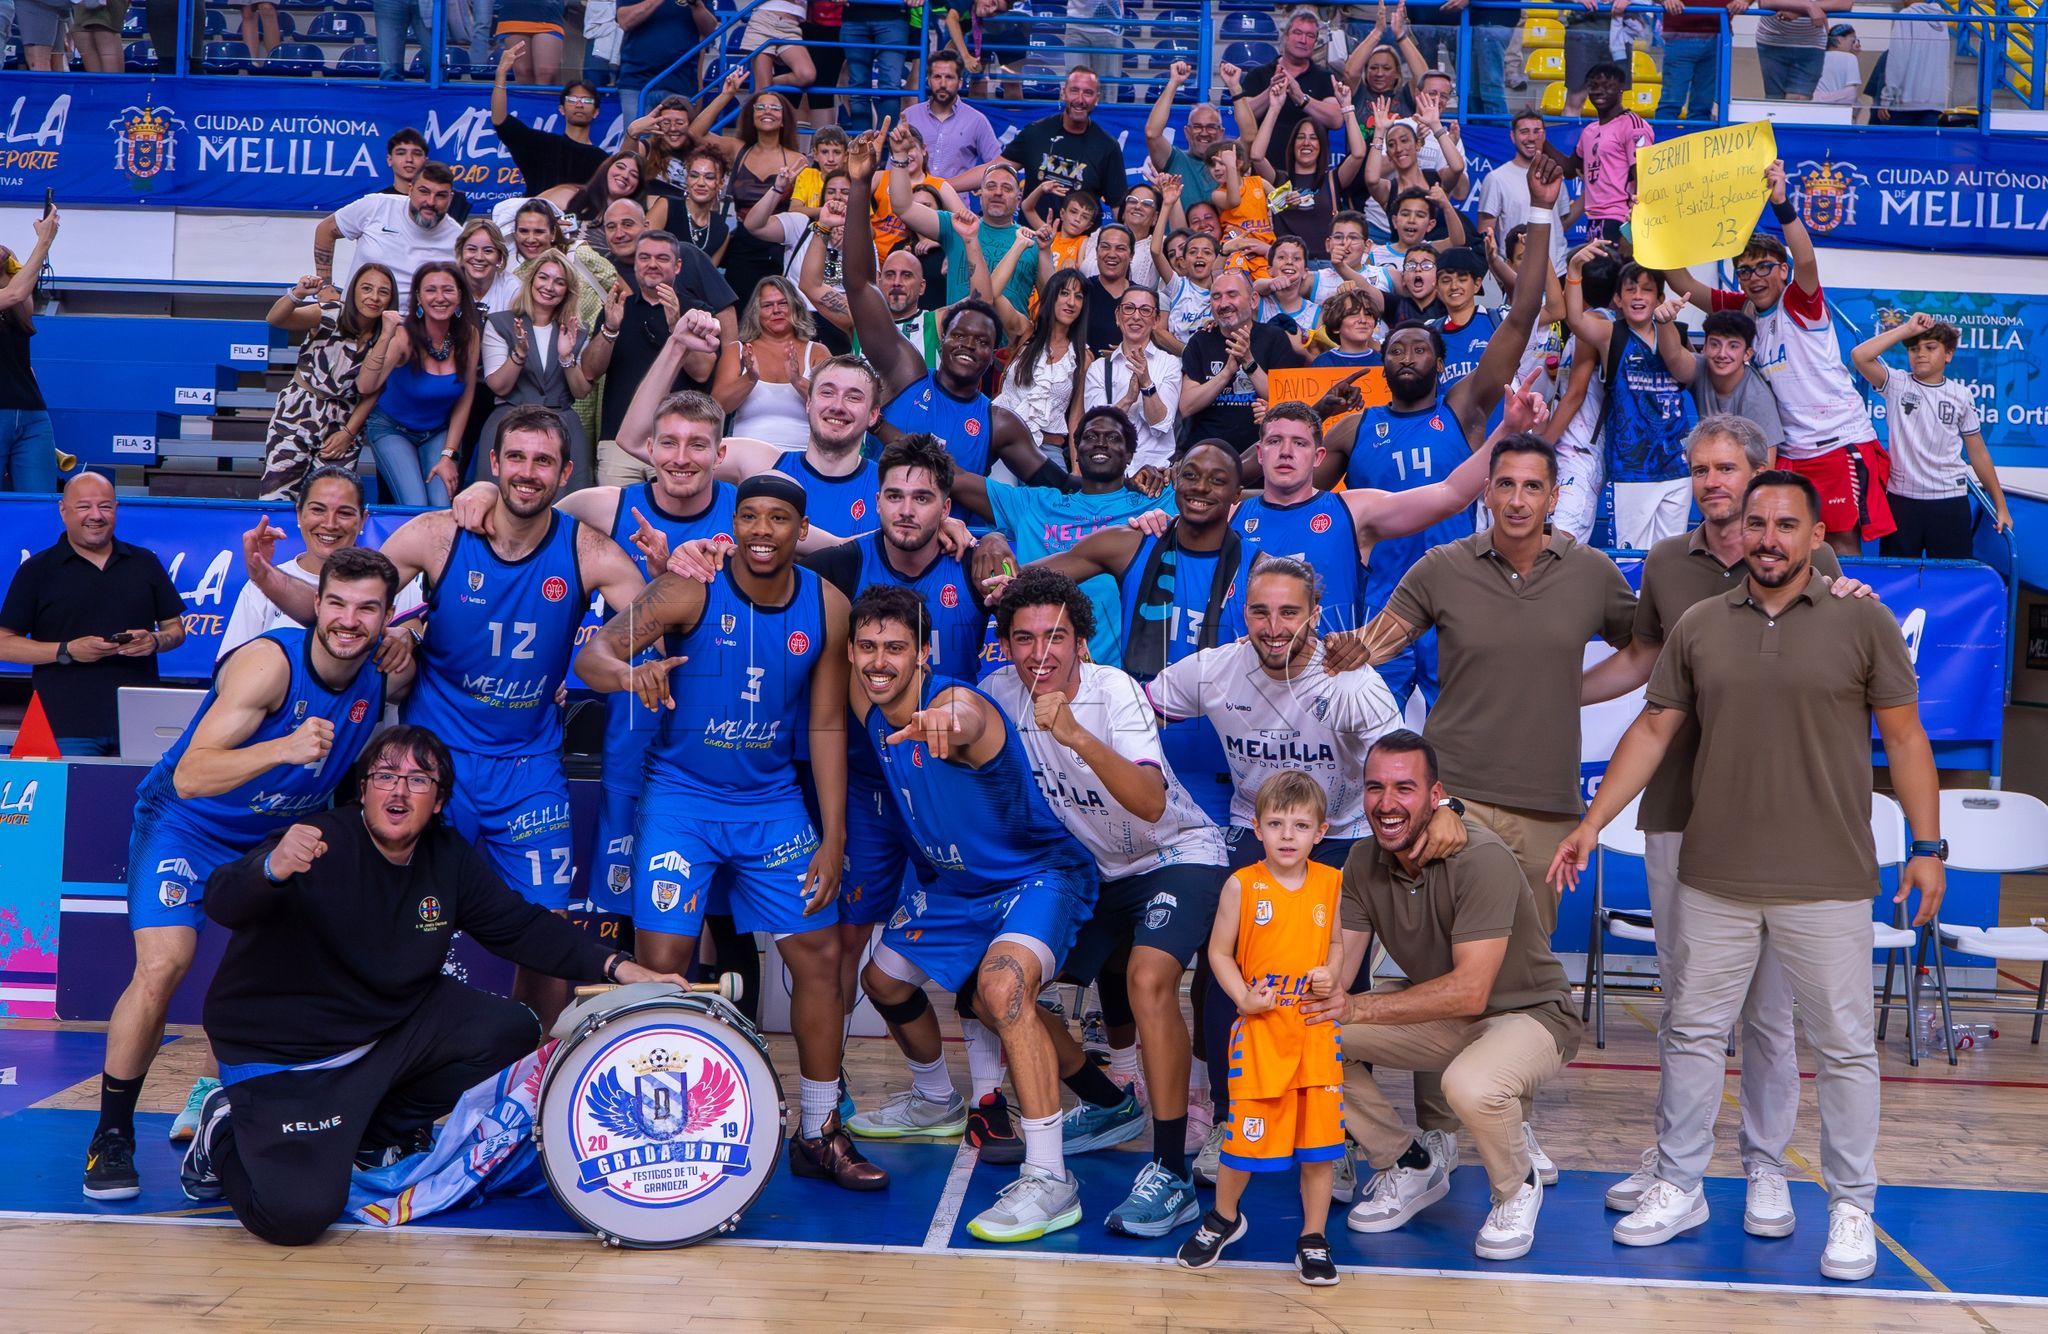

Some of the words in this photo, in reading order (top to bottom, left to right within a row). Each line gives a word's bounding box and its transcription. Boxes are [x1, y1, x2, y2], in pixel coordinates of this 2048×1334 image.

[194, 114, 263, 132] CIUDAD
[270, 115, 380, 137] AUTÓNOMA
[211, 135, 224, 145] DE
[1703, 126, 1758, 160] PAVLOV
[0, 150, 59, 169] EPORTE
[197, 135, 380, 178] MELILLA
[1644, 187, 1669, 205] can
[1702, 171, 1729, 199] give
[1736, 166, 1757, 176] me
[1876, 169, 1949, 185] CIUDAD
[1955, 169, 2048, 190] AUTÓNO
[1895, 190, 1907, 199] DE
[1712, 218, 1738, 248] 23
[1960, 313, 2024, 327] AUTÓNOMA
[1956, 328, 2024, 350] LILLA
[233, 346, 252, 355] FILA
[257, 347, 265, 359] 5
[178, 390, 198, 400] FILA
[202, 391, 212, 403] 4
[1274, 377, 1320, 401] DAVID
[2006, 404, 2048, 425] Orti
[116, 438, 138, 448] FILA
[142, 439, 152, 451] 3
[1392, 447, 1431, 480] 14
[488, 622, 537, 660] 12
[463, 673, 547, 699] MELILLA
[741, 667, 765, 702] 3
[705, 718, 781, 741] MELILLA
[1260, 730, 1301, 741] CLUB
[1226, 735, 1335, 762] MELILLA
[1229, 752, 1336, 772] BALONCESTO
[525, 847, 571, 886] 12
[282, 1115, 342, 1133] KELME
[720, 1122, 738, 1138] 19
[588, 1135, 608, 1152] 20
[598, 1143, 671, 1175] GRADA
[685, 1142, 731, 1162] UDM
[632, 1168, 673, 1182] TESTIGOS
[674, 1167, 685, 1178] DE
[686, 1166, 698, 1177] TU
[644, 1180, 688, 1194] GRANDEZA
